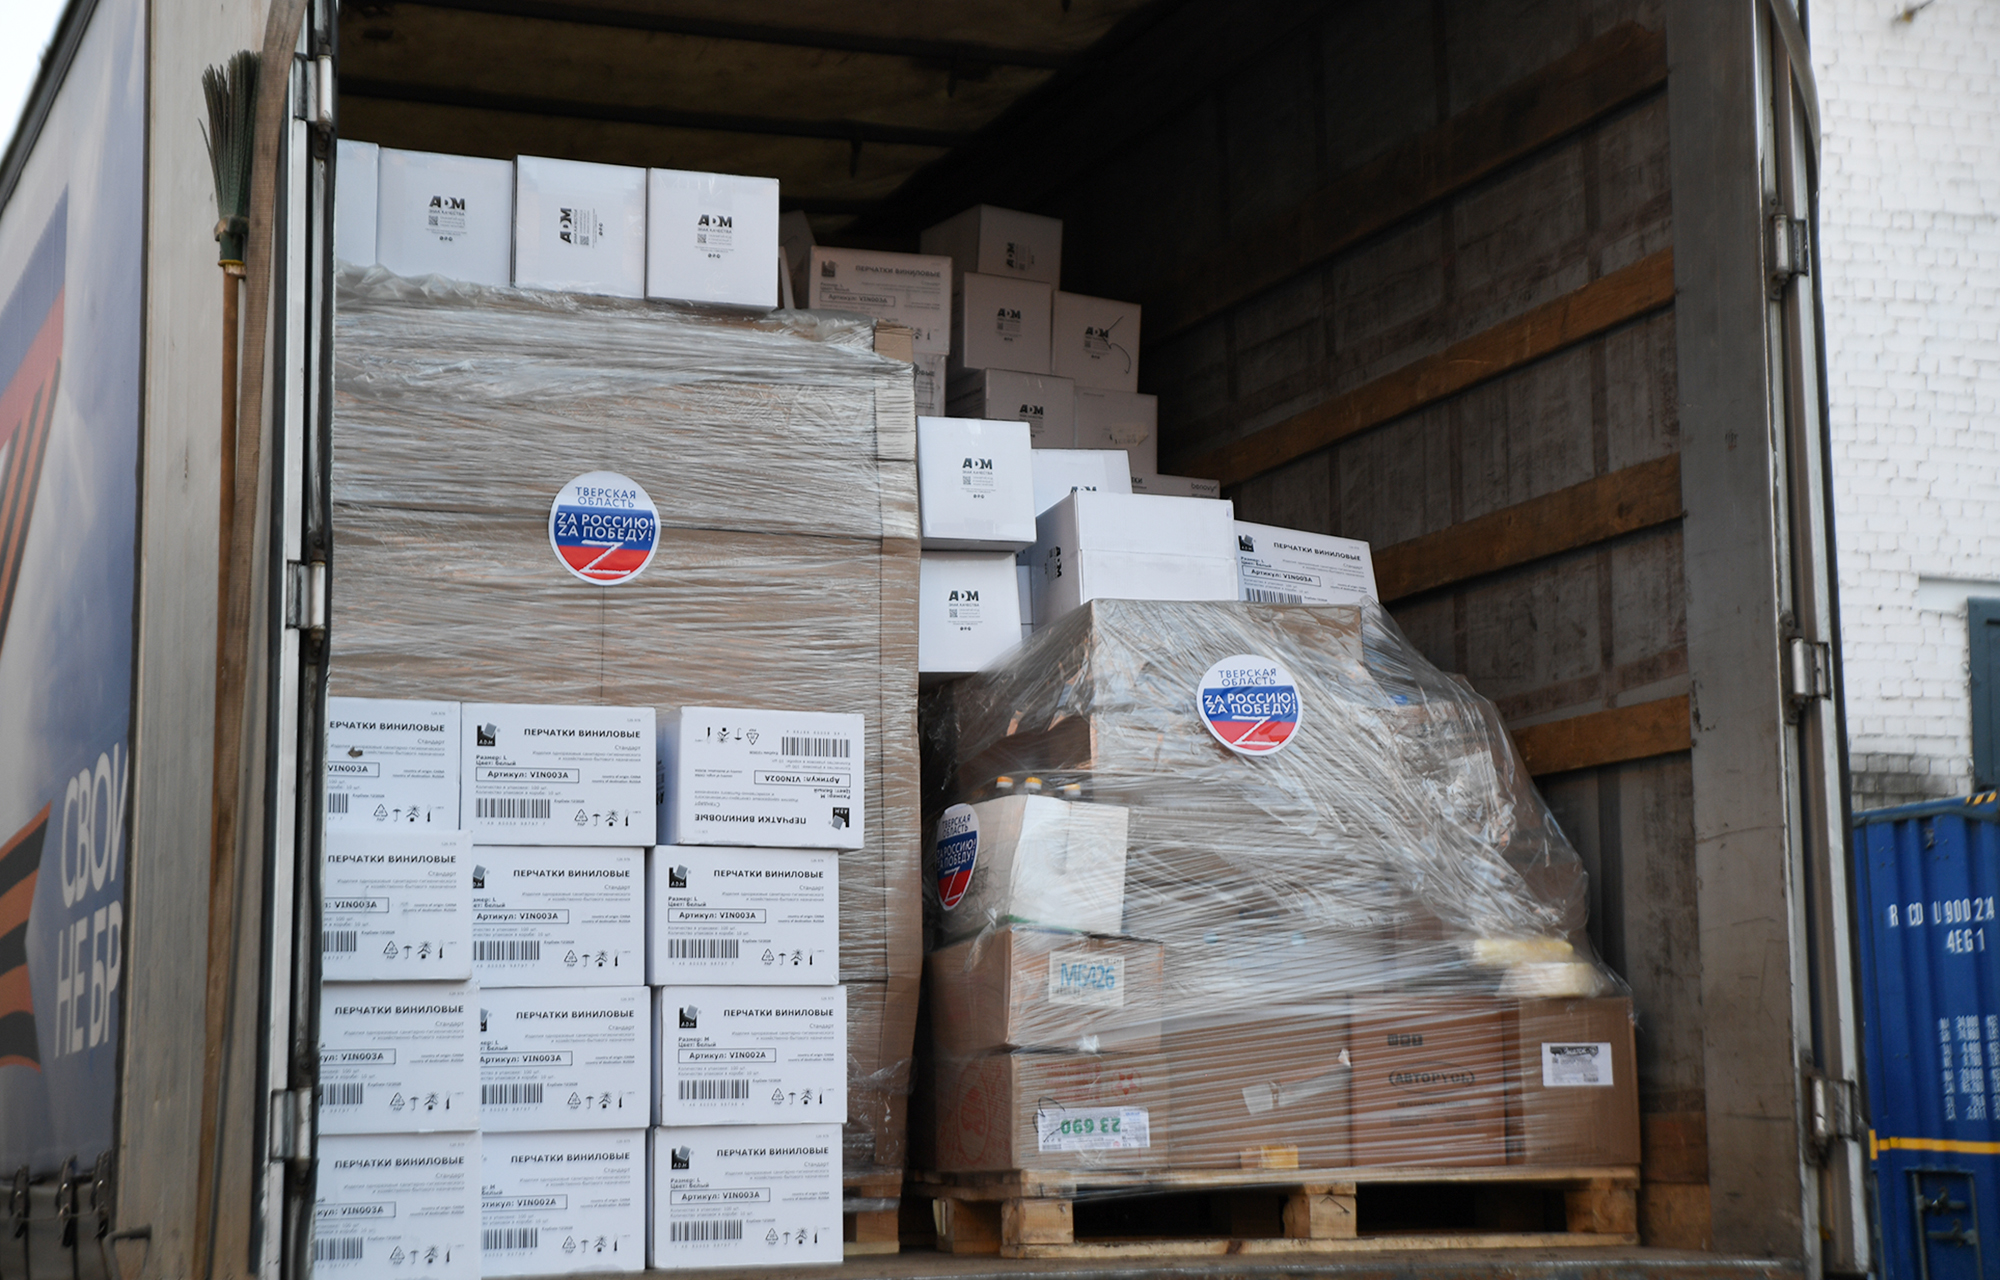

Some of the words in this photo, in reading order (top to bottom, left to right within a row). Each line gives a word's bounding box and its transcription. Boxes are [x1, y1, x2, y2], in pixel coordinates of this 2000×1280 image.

[856, 265, 894, 274] ПЕРЧАТКИ
[895, 268, 940, 278] ВИНИЛОВЫЕ
[575, 486, 636, 500] ТВЕРСКАЯ
[578, 497, 635, 508] ОБЛАСТЬ
[582, 514, 653, 530] РОССИЮ!
[583, 526, 653, 542] ПОБЕДУ!
[1273, 542, 1312, 554] ПЕРЧАТКИ
[1314, 549, 1361, 561] ВИНИЛОВЫЕ
[1218, 668, 1277, 679] ТВЕРСКАЯ
[1222, 677, 1276, 687] ОБЛАСТЬ
[1227, 693, 1296, 704] РОССИЮ!
[1231, 703, 1297, 716] ПОБЕДУ!
[330, 721, 377, 730] ЕРЧАТКИ
[380, 722, 445, 732] ВИНИЛОВЫЕ
[524, 728, 576, 737] ПЕРЧАТКИ
[578, 729, 641, 739] ВИНИЛОВЫЕ
[328, 765, 369, 773] VIN003A
[488, 771, 528, 779] Артикул:
[530, 771, 569, 779] VIN003A
[765, 775, 801, 783] VIN002A
[803, 776, 840, 784] Артикул:
[695, 814, 755, 823] ВИНИЛОВЫЕ
[758, 816, 807, 825] ПЕРЧАТКИ
[328, 855, 385, 863] ПЕРЧАТКИ
[388, 855, 457, 864] ВИНИЛОВЫЕ
[514, 870, 565, 878] ПЕРЧАТКИ
[568, 870, 631, 878] ВИНИЛОВЫЕ
[714, 870, 762, 878] ПЕРЧАТКИ
[765, 870, 824, 879] ВИНИЛОВЫЕ
[477, 913, 517, 921] Артикул:
[679, 912, 718, 920] Артикул:
[720, 912, 757, 920] VIN003A
[55, 916, 88, 1059] НЕ
[335, 1005, 392, 1015] ПЕРЧАТКИ
[395, 1005, 464, 1015] ВИНИЛОВЫЕ
[516, 1011, 569, 1020] ПЕРЧАТКИ
[572, 1010, 635, 1019] ВИНИЛОВЫЕ
[723, 1009, 773, 1017] ПЕРЧАТКИ
[775, 1009, 834, 1017] ВИНИЛОВЫЕ
[341, 1053, 384, 1061] VIN003A
[480, 1056, 520, 1064] Артикул:
[689, 1052, 727, 1060] Артикул:
[717, 1149, 766, 1157] ПЕРЧАТКИ
[769, 1147, 829, 1156] ВИНИЛОВЫЕ
[335, 1159, 392, 1169] ПЕРЧАТКИ
[395, 1156, 465, 1167] ВИНИЛОВЫЕ
[511, 1155, 564, 1164] ПЕРЧАТКИ
[567, 1152, 631, 1162] ВИНИЛОВЫЕ
[682, 1192, 720, 1201] Артикул:
[723, 1191, 760, 1199] VIN003A
[482, 1200, 514, 1208] тикул:
[518, 1198, 557, 1207] VIN002A
